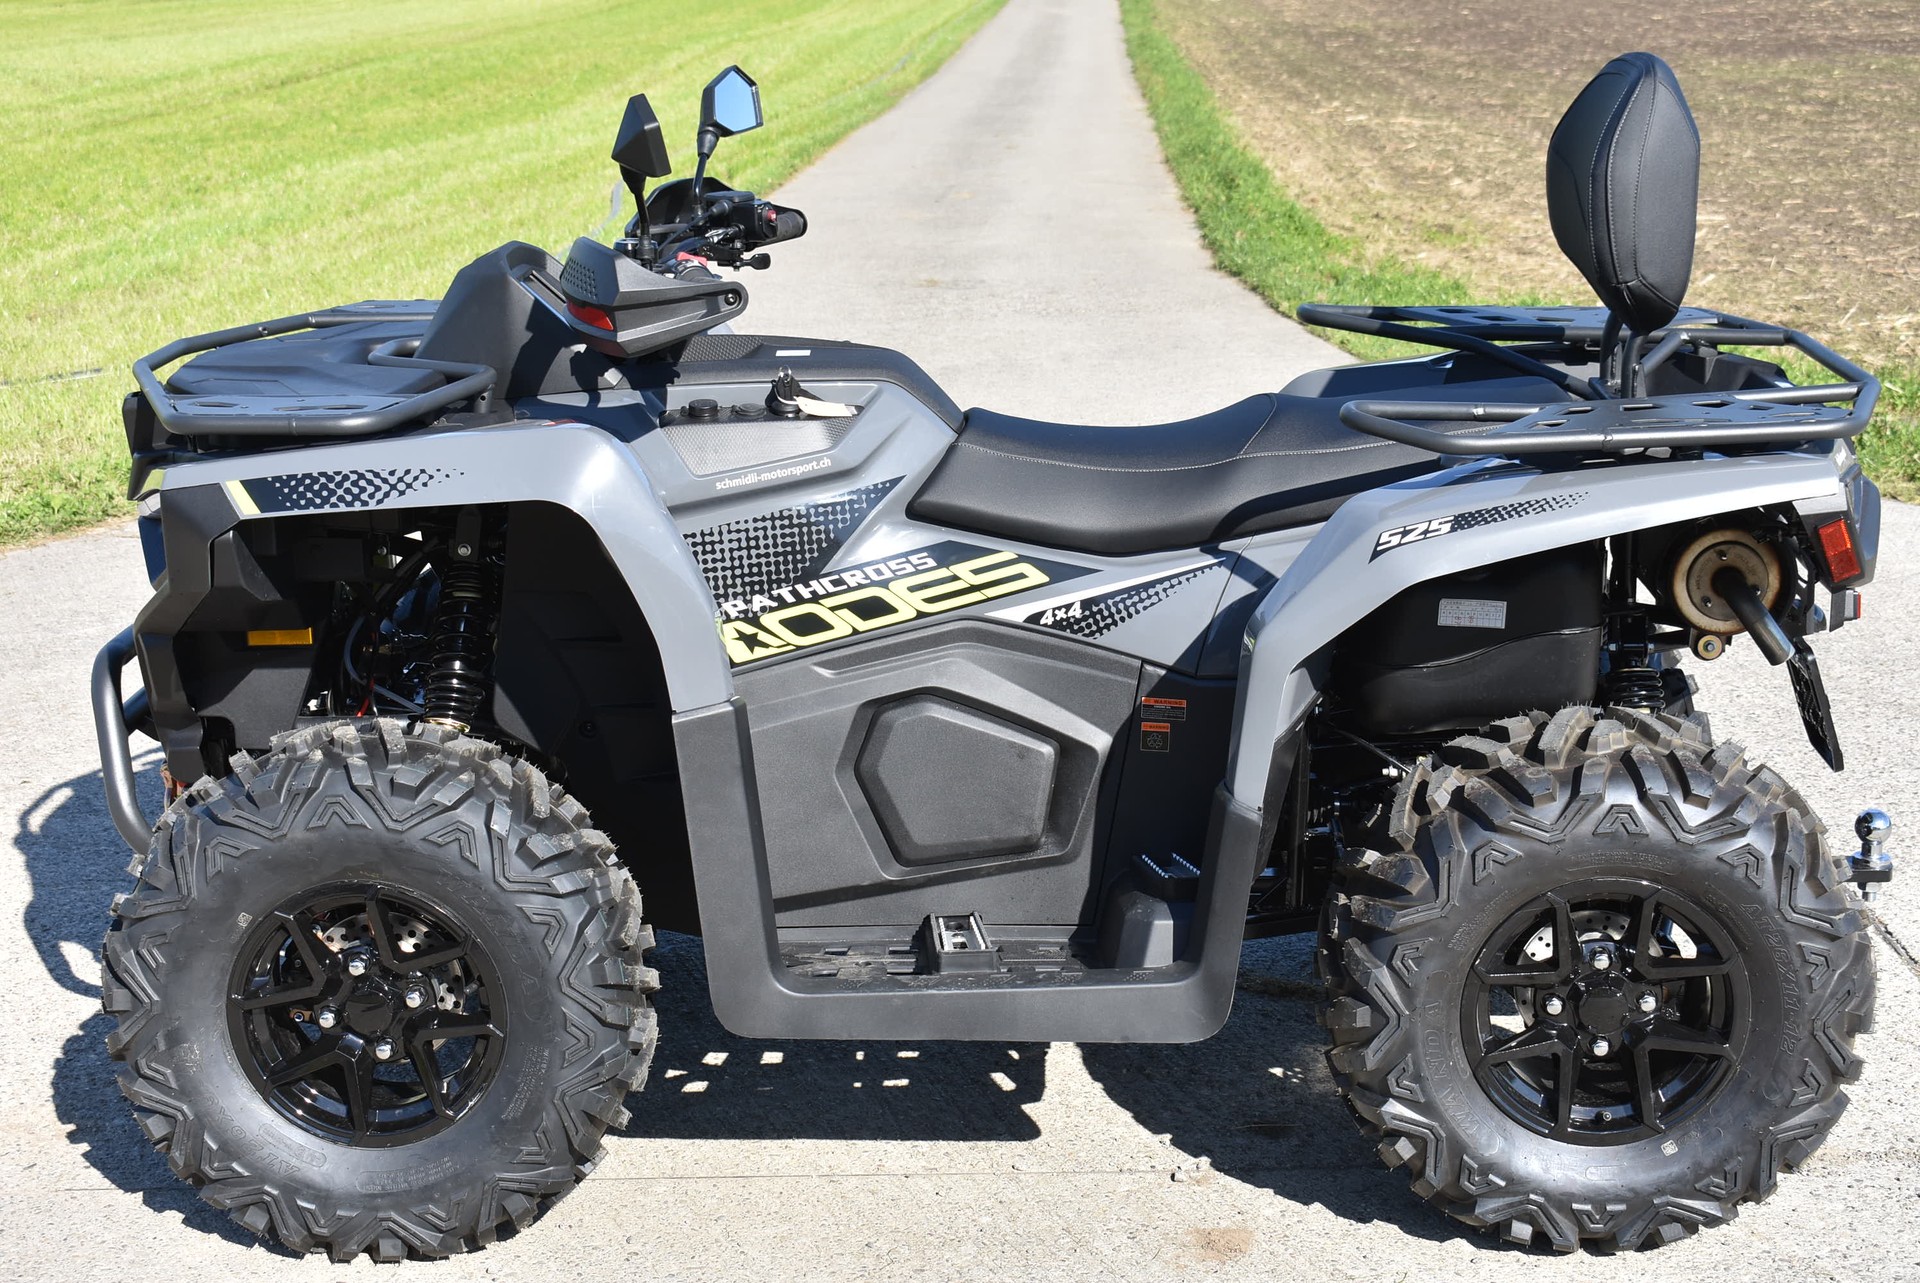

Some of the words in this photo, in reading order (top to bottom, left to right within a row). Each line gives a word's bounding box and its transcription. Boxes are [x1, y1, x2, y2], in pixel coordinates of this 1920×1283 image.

[716, 457, 832, 490] schmidli-motorsport.ch
[1377, 516, 1454, 551] 525
[721, 552, 938, 619] PATHCROSS
[1424, 1001, 1481, 1136] WANDA
